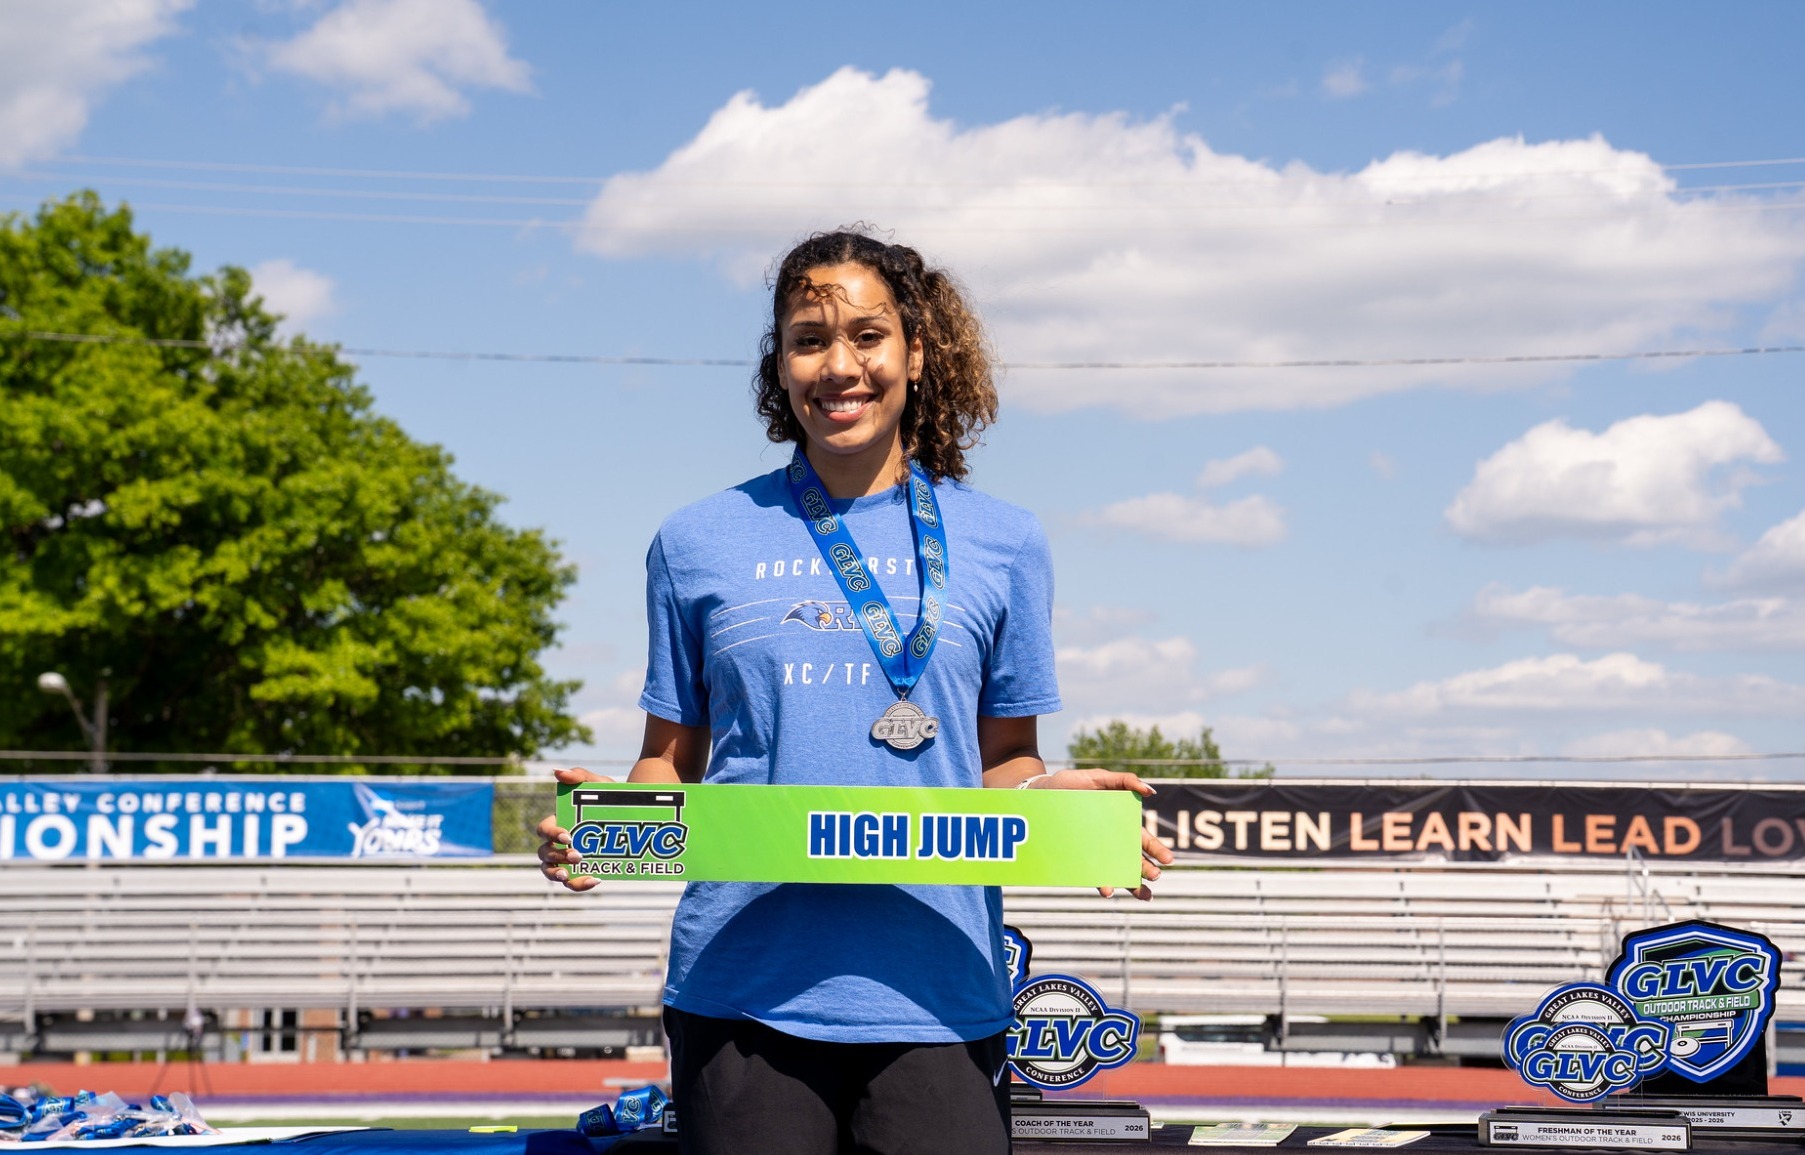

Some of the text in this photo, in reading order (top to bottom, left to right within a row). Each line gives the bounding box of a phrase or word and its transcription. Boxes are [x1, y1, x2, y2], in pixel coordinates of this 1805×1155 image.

[800, 487, 838, 535] GLVC
[756, 557, 914, 580] ROCKRST
[830, 543, 871, 592] GLVC
[924, 534, 945, 590] GLVC
[861, 601, 903, 657] GLVC
[910, 595, 941, 659] GLVC
[871, 717, 939, 739] GLVC
[0, 792, 307, 813] LLEY CONFERENCE
[0, 813, 308, 859] IONSHIP
[570, 822, 687, 859] GLVC
[809, 813, 1027, 860] HIGH JUMP
[1146, 810, 1332, 850] LISTEN
[1350, 811, 1532, 852] LEARN
[1552, 813, 1702, 855] LEAD
[572, 862, 684, 874] TRACK & FIELD
[1625, 955, 1762, 1000] GLVC
[1014, 983, 1098, 1012] GREAT LAKES VALLEY
[1544, 991, 1631, 1020] GREAT LAKES VALLEY
[1643, 995, 1751, 1015] OUTDOOR TRACK & FIELD
[1660, 1010, 1737, 1023] CHAMPIONSHIP
[1548, 1032, 1566, 1048] GREAT
[1589, 1030, 1611, 1049] VALLEY
[1025, 1066, 1085, 1082] CONFERENCE
[1526, 1051, 1634, 1082] GLVC
[1559, 1086, 1602, 1098] CONFERENCE
